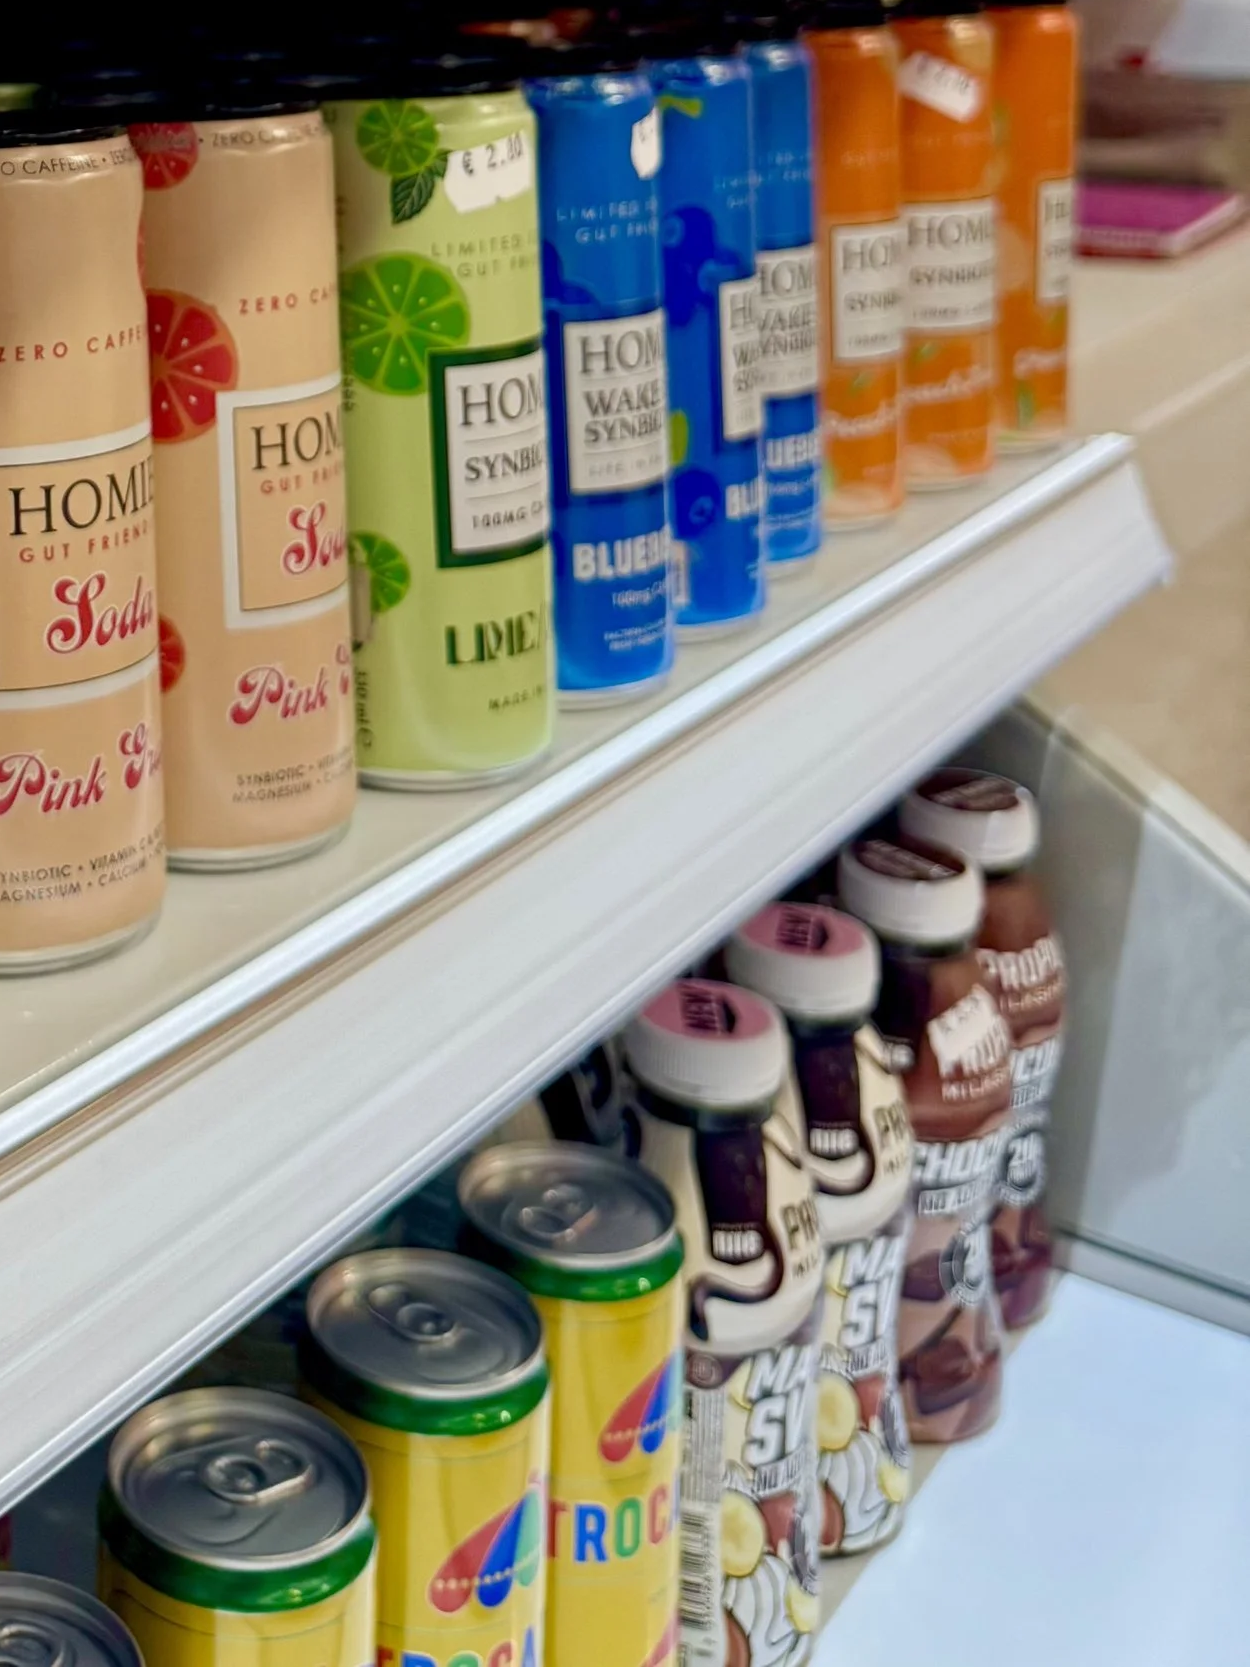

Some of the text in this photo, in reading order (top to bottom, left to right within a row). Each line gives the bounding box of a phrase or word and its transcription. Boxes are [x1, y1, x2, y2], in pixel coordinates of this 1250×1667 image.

[22, 156, 99, 176] CAFFEINE
[238, 292, 299, 315] ZERO
[18, 542, 70, 563] GUT
[444, 602, 546, 667] LIME
[228, 665, 330, 726] Pink
